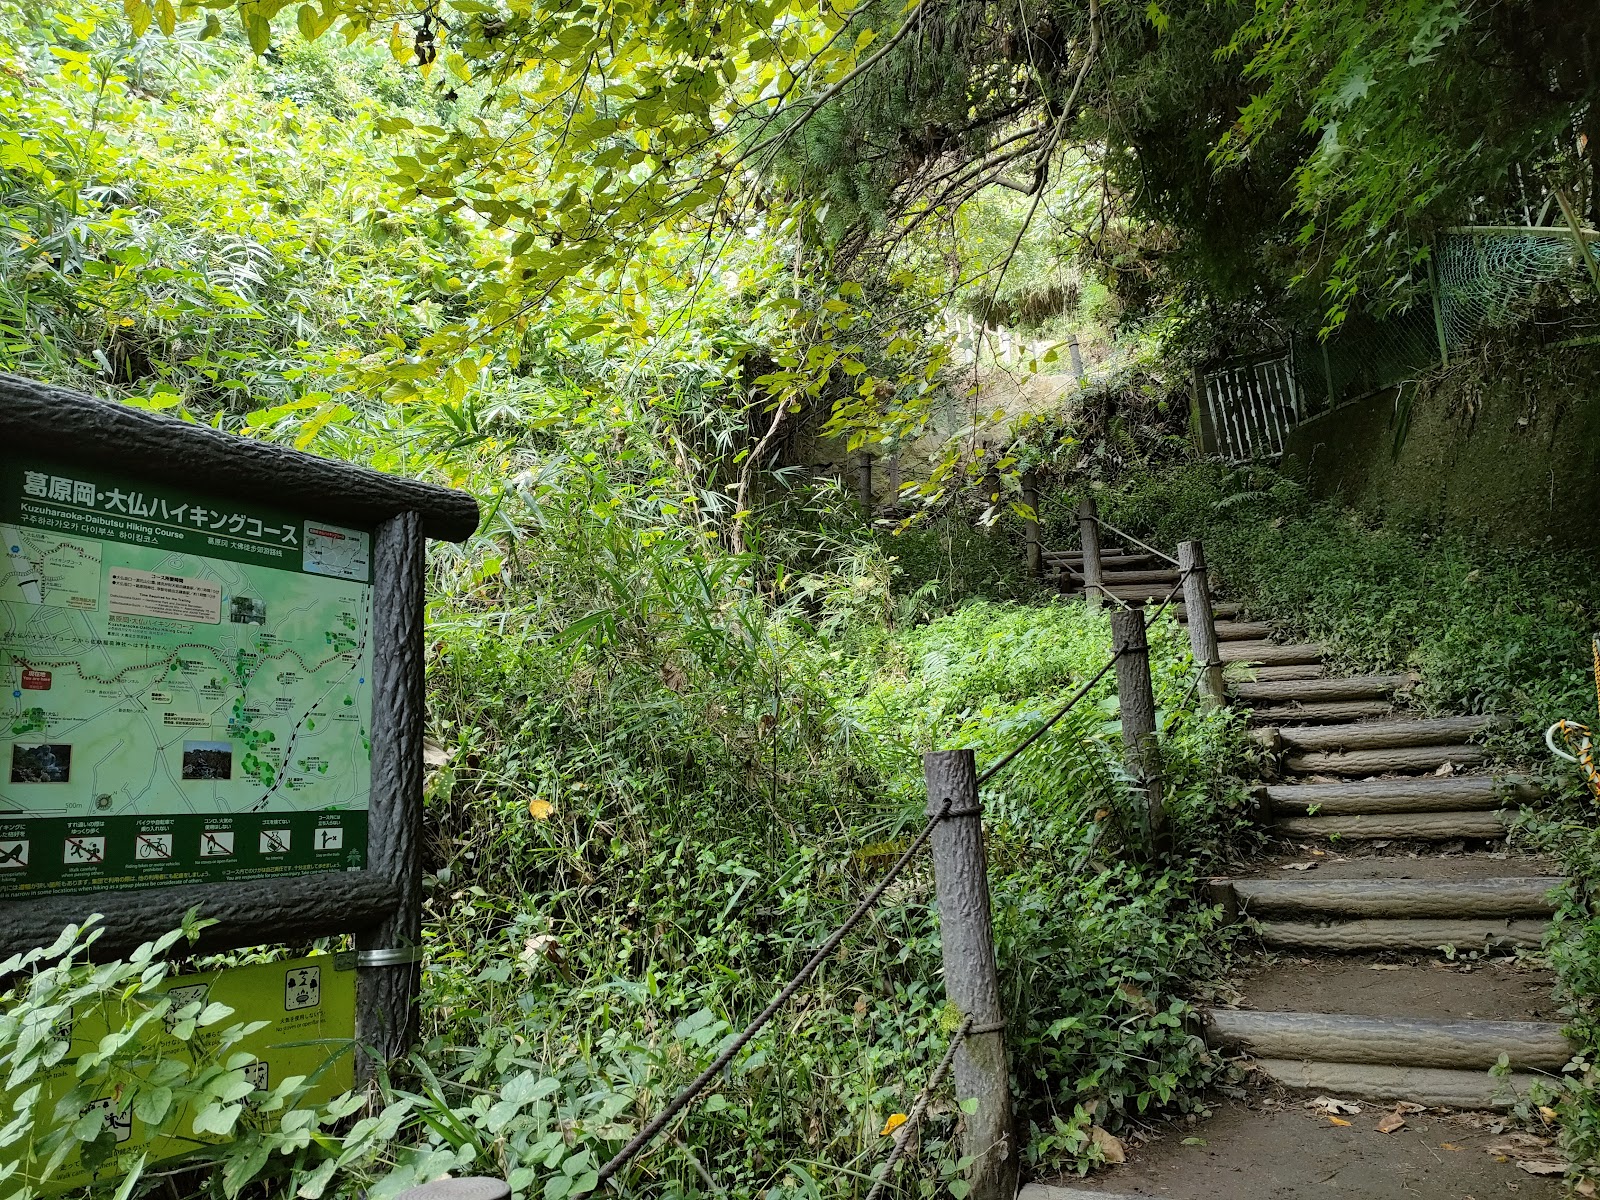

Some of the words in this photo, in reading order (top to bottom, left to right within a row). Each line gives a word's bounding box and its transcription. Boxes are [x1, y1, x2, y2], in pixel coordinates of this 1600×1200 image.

[23, 471, 298, 545] 葛原岡・大仏ハイキングコース
[20, 503, 124, 528] Kuzuharaoka-Daibutsu
[126, 521, 153, 535] Hiking
[154, 527, 184, 540] Course
[93, 884, 109, 892] hiking
[134, 881, 149, 889] please
[241, 873, 264, 881] responsible
